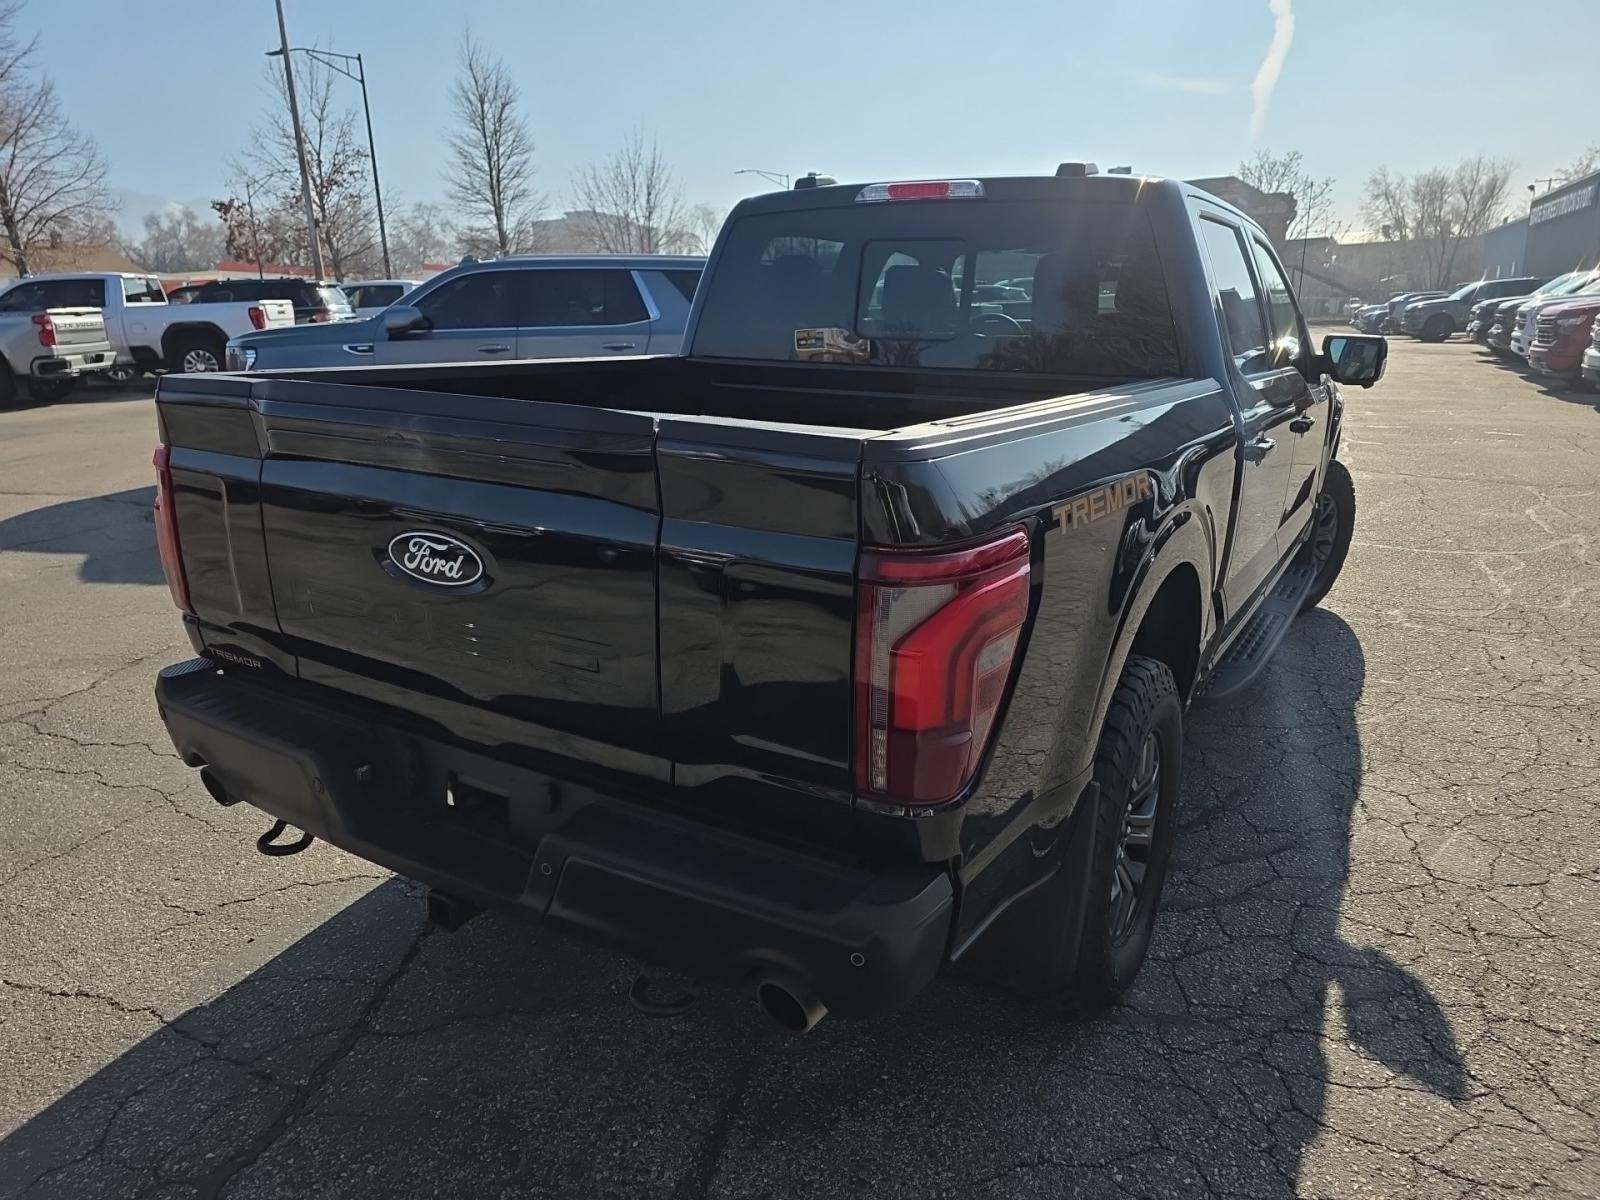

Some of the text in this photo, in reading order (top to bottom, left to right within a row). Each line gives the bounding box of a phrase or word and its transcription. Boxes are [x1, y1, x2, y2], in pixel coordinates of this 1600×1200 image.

[1052, 471, 1153, 534] TREMOR
[404, 538, 464, 579] Ford
[208, 646, 263, 669] TREMOR
